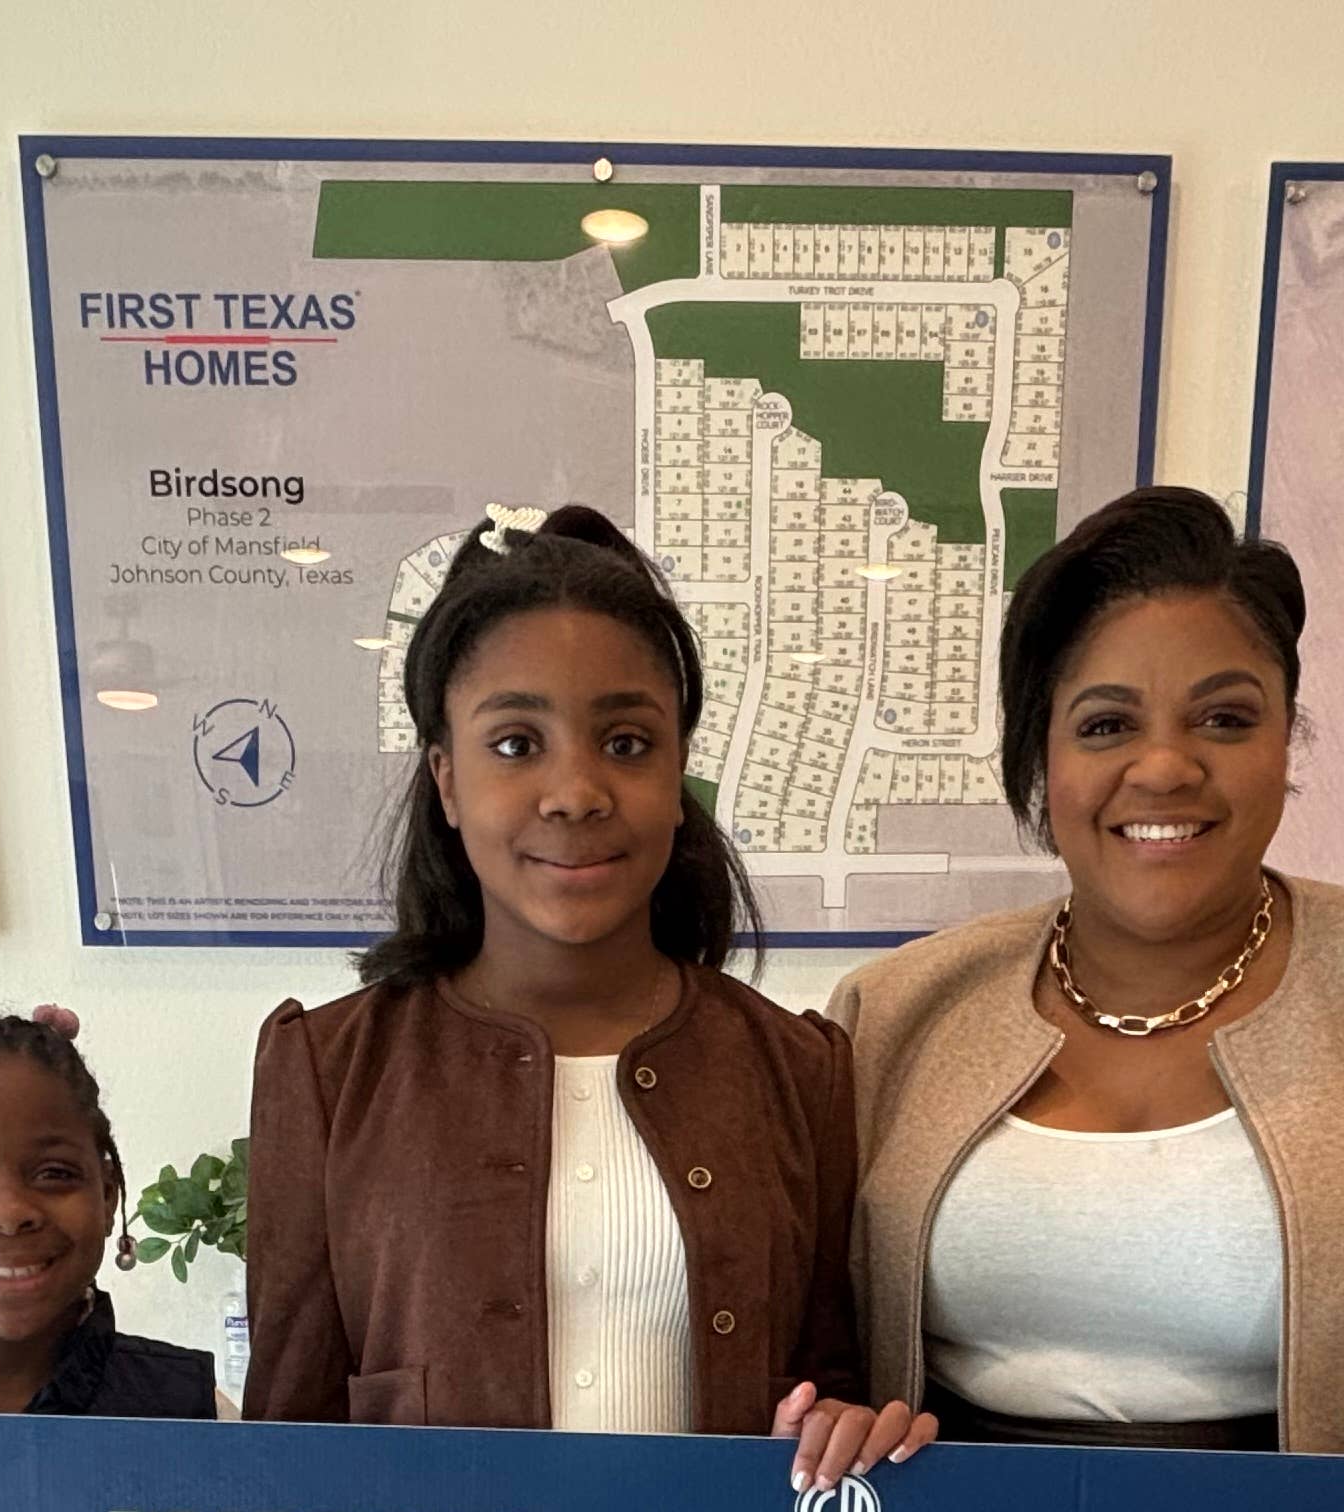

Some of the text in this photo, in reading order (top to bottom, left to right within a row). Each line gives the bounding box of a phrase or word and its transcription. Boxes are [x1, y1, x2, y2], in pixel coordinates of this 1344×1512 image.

[788, 286, 821, 296] TURKEY
[848, 286, 874, 296] DRIVE
[79, 293, 356, 330] FIRST TEXAS
[144, 350, 298, 386] HOMES
[149, 466, 305, 505] Birdsong
[1029, 473, 1053, 482] DRIVE
[186, 507, 272, 527] Phase 2
[141, 535, 183, 560] City
[187, 535, 209, 556] of
[110, 565, 354, 589] Johnson County, Texas
[258, 698, 277, 719] N
[192, 714, 214, 738] W
[279, 770, 296, 791] E
[212, 787, 229, 806] S
